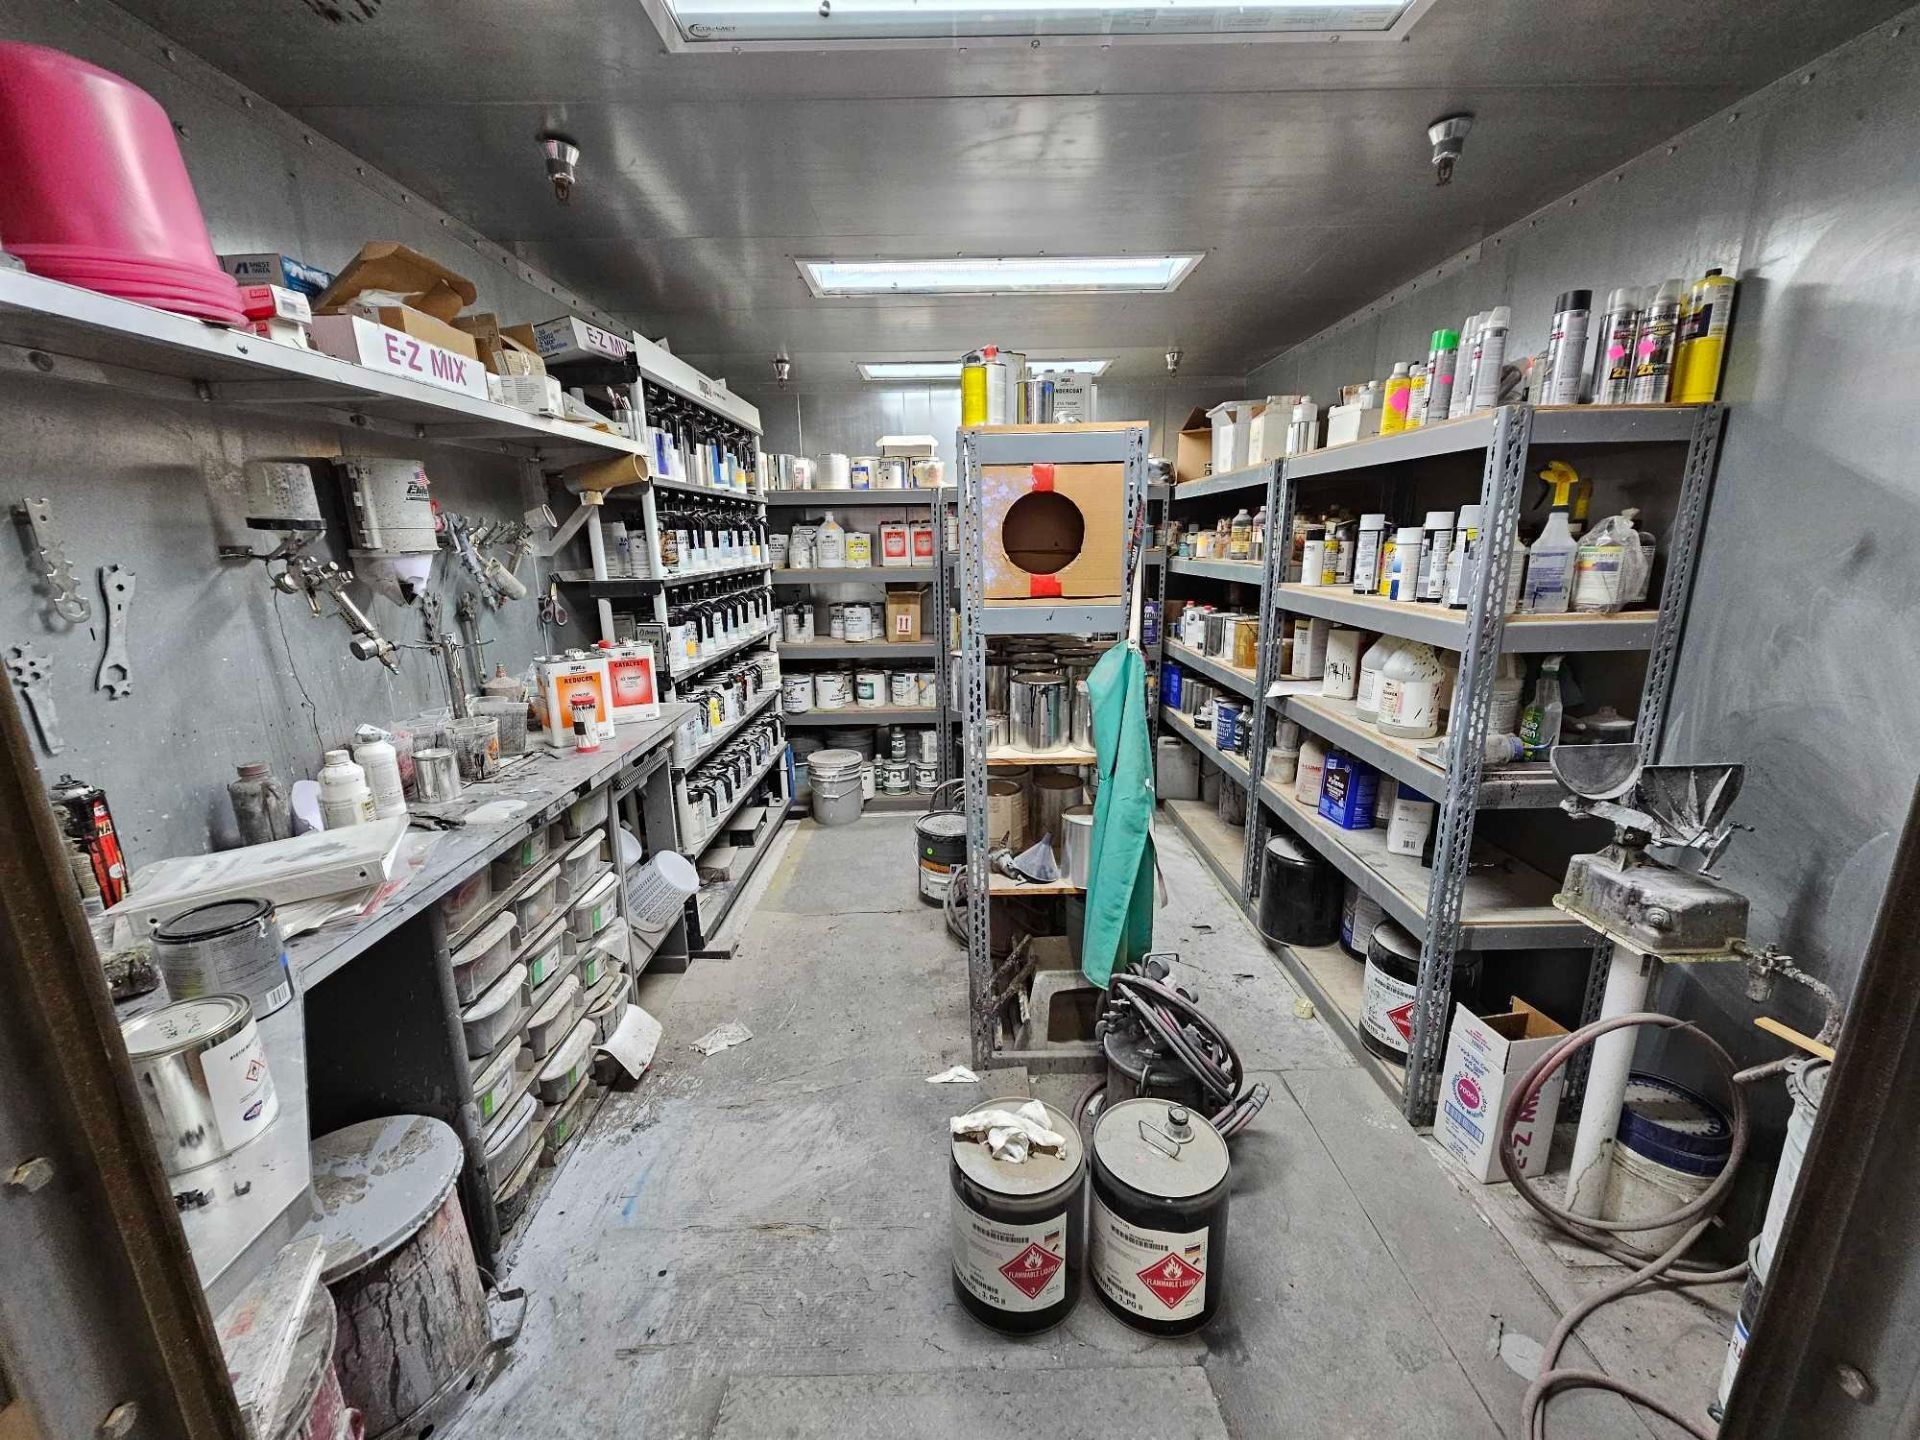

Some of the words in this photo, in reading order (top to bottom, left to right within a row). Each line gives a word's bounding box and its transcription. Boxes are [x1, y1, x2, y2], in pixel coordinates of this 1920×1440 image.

[586, 326, 607, 349] E-Z
[384, 332, 423, 373] E-Z
[430, 348, 468, 387] MIX
[1055, 387, 1083, 395] NDERCOAT
[614, 660, 644, 668] CATALYST
[563, 675, 594, 685] REDUCER
[1008, 1270, 1040, 1279] FLAMMABLE
[1146, 1277, 1179, 1288] FLAMMABLE
[1179, 1278, 1198, 1287] LIQUID
[1030, 1286, 1036, 1295] 3
[989, 1294, 1000, 1304] PG
[1169, 1296, 1175, 1304] 3
[1126, 1299, 1137, 1310] PG
